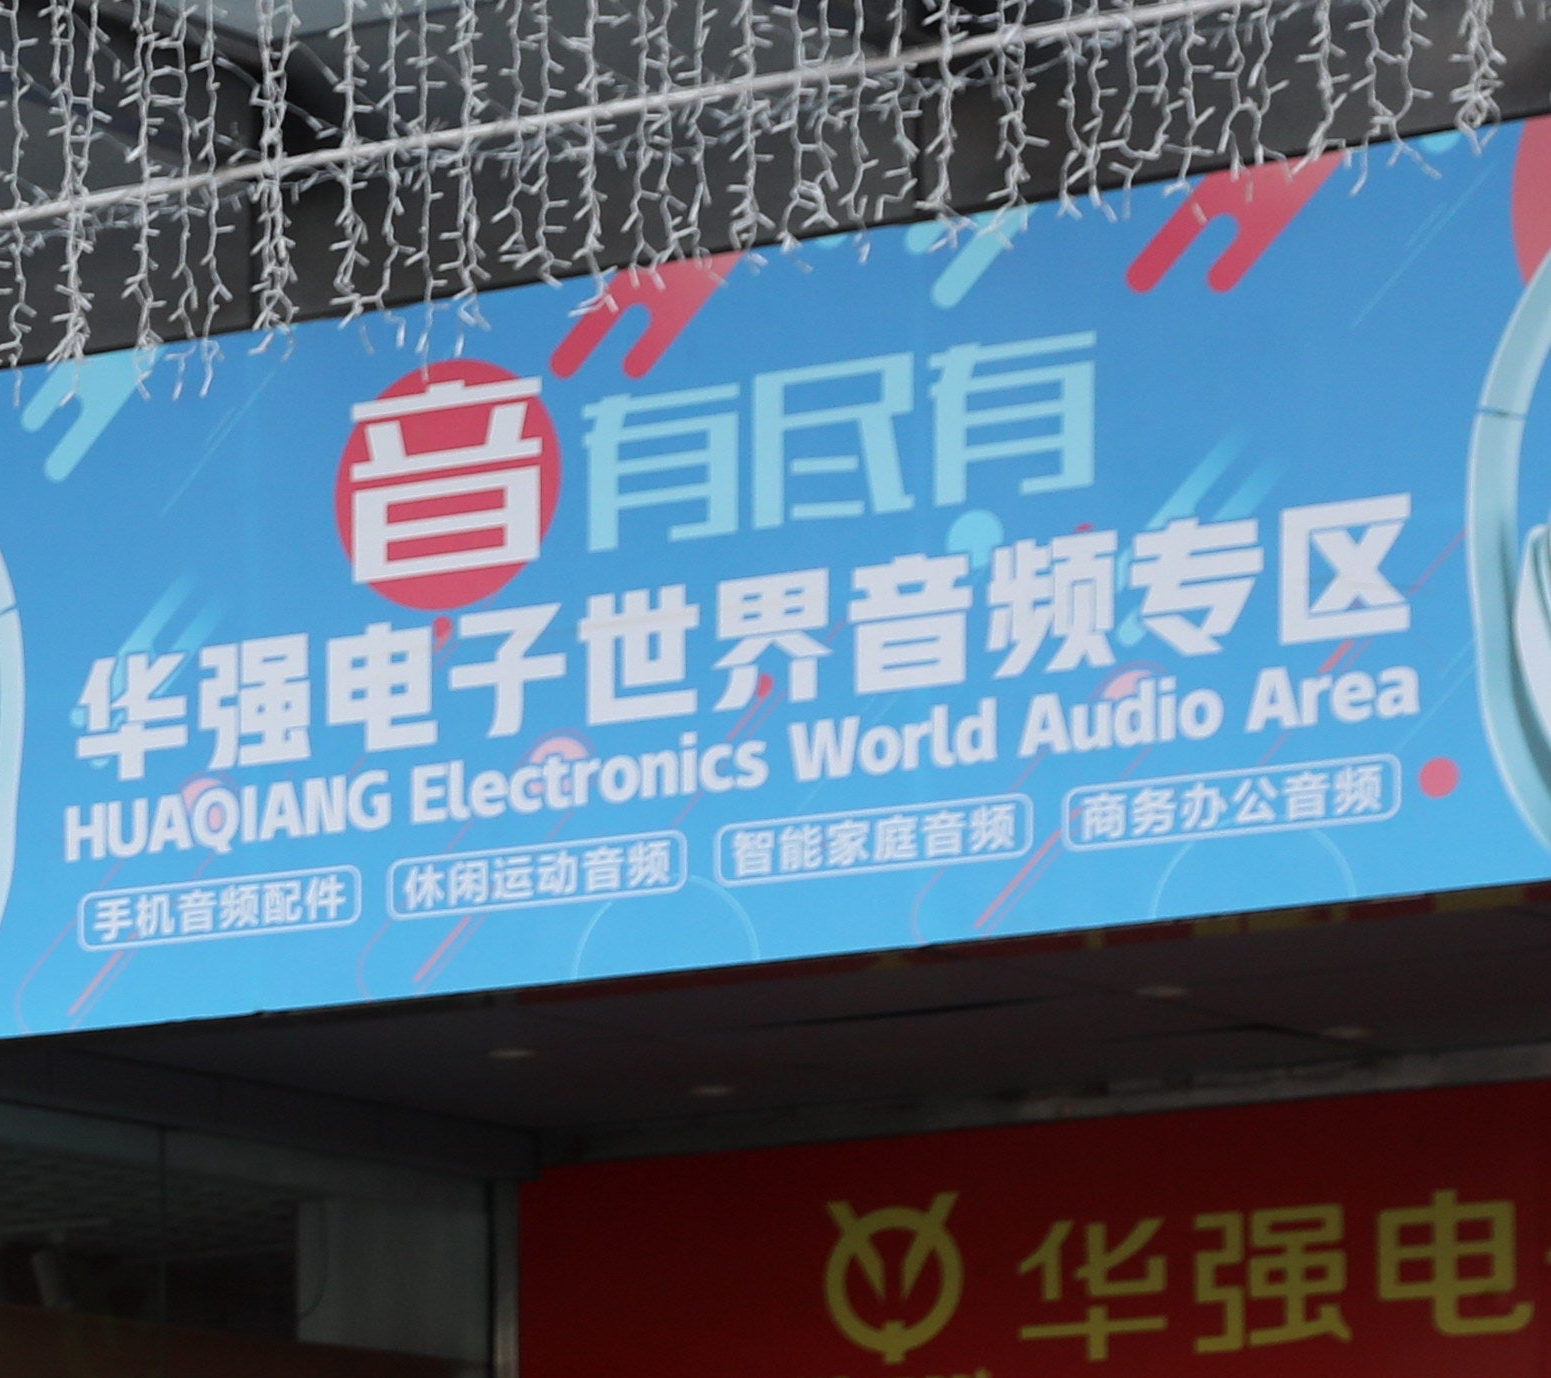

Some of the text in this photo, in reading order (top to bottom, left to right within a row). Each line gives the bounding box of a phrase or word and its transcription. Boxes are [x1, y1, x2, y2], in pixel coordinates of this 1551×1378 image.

[75, 492, 1413, 782] 华强电子世界音频专区
[63, 663, 1420, 863] HUAQIANG Electronics World Audio Area
[93, 763, 1383, 944] 手机音频配件 休闲运动音频 智能家庭音频 商务办公音频
[1018, 1190, 1551, 1363] 华强电
